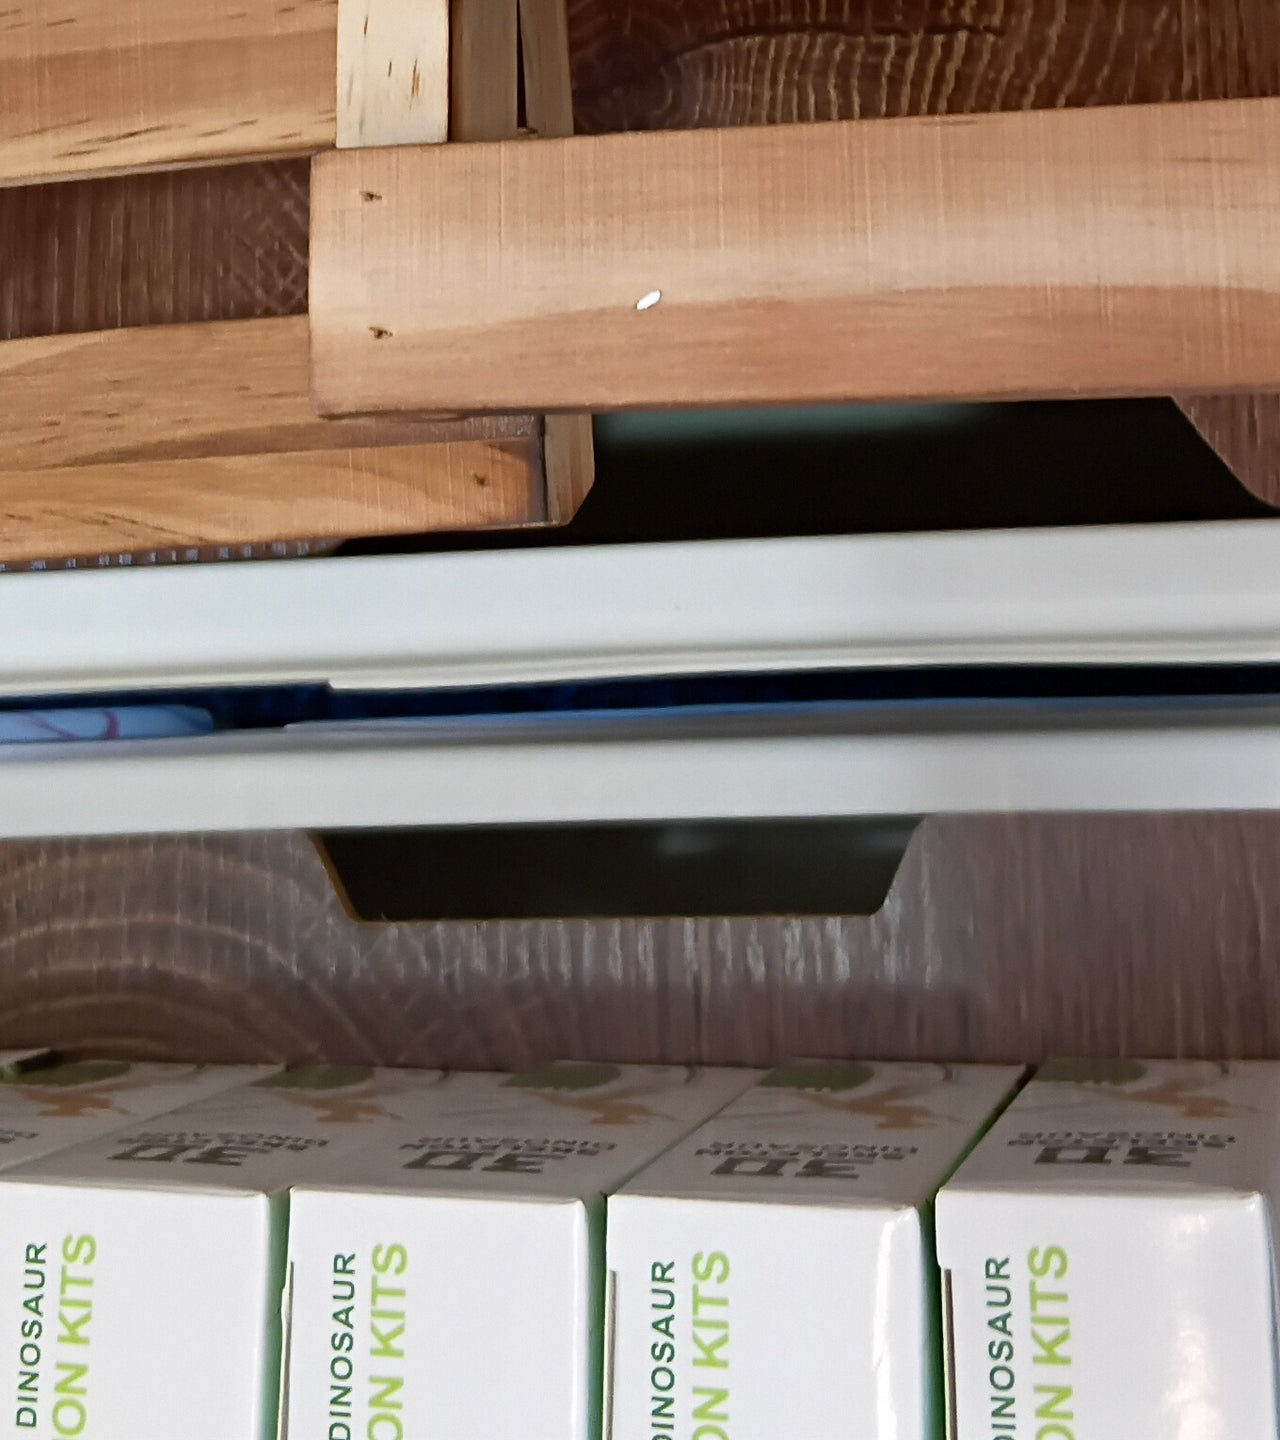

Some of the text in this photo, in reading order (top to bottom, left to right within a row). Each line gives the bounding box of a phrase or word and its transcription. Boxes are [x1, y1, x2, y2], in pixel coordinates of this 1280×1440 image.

[401, 1151, 566, 1173] 3D
[710, 1158, 874, 1179] 3D
[1034, 1146, 1196, 1167] 3D
[15, 1243, 48, 1428] DINOSAUR
[56, 1234, 98, 1348] KITS
[327, 1252, 357, 1440] DINOSAUR
[369, 1243, 409, 1359] KITS
[650, 1260, 676, 1440] INOSAUR
[692, 1251, 731, 1370] KITS
[983, 1256, 1018, 1440] INOSAUR
[1028, 1246, 1073, 1368] KITS
